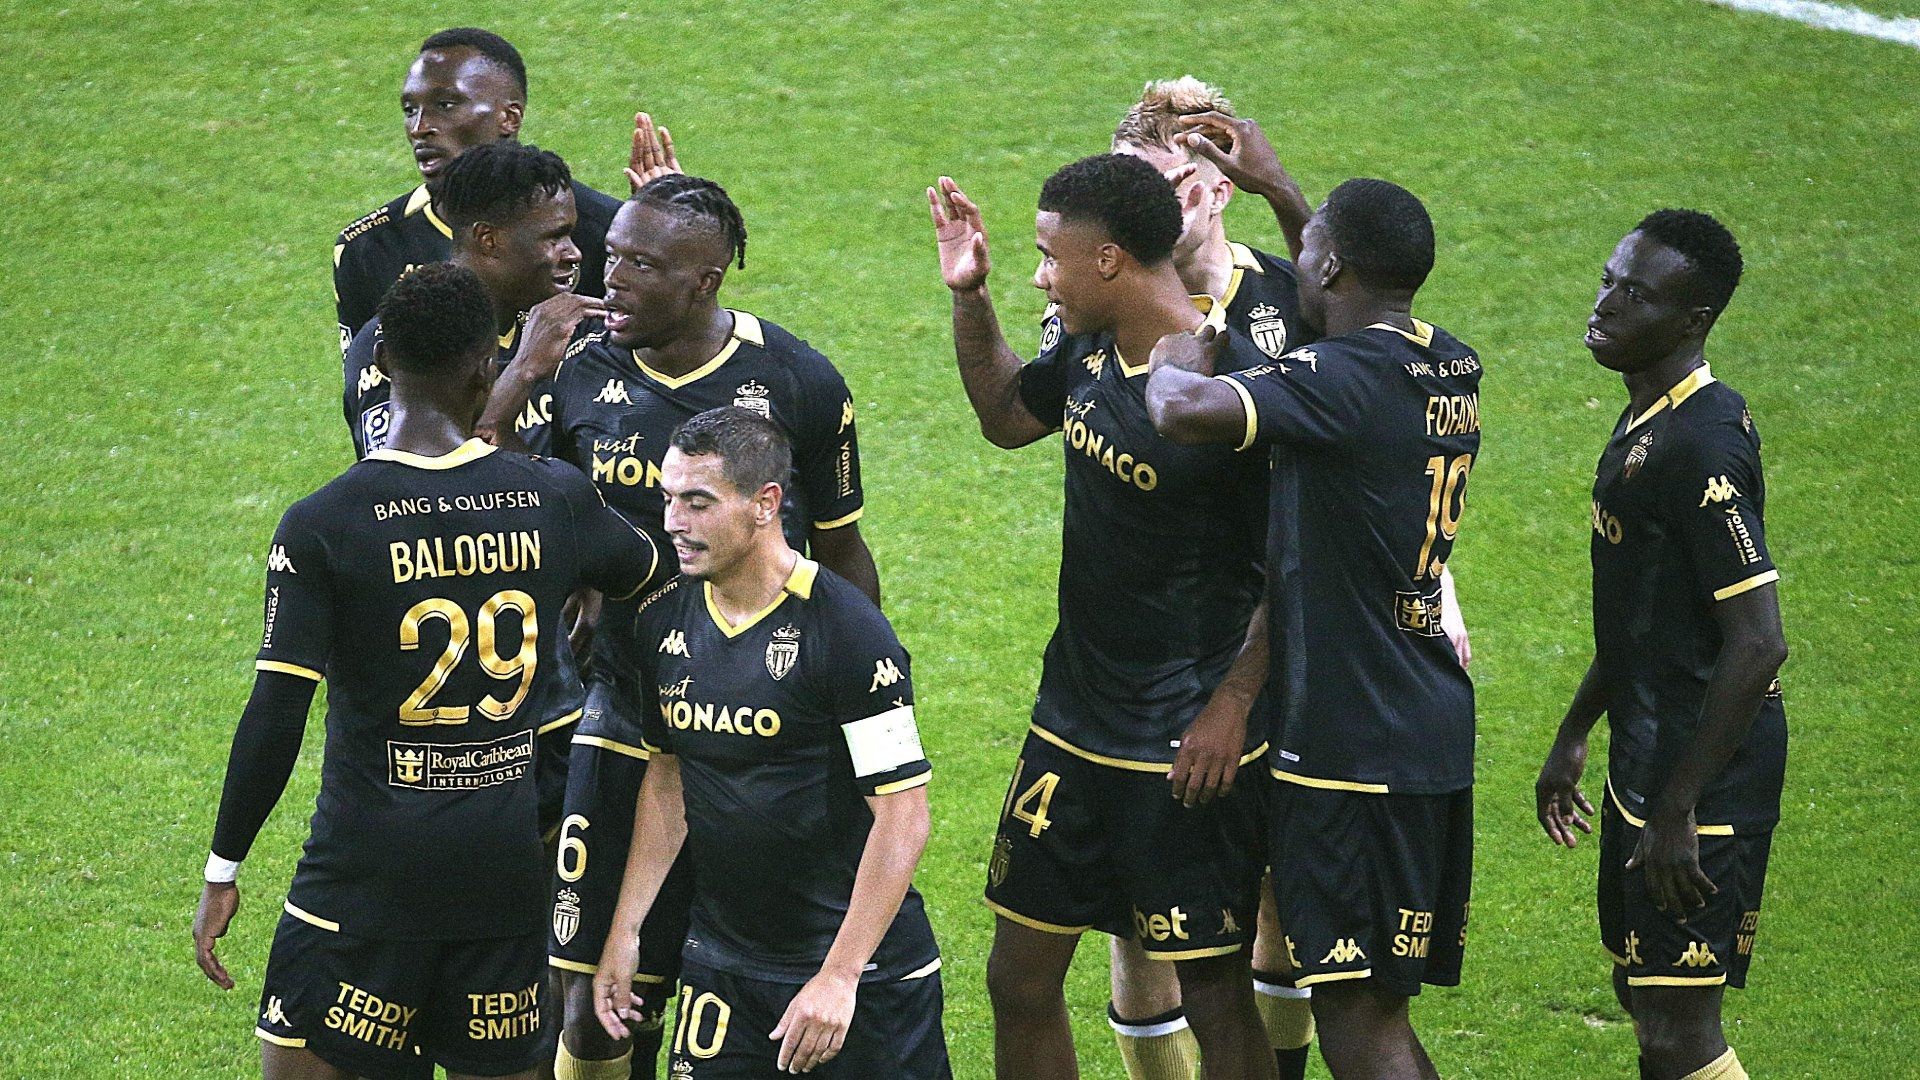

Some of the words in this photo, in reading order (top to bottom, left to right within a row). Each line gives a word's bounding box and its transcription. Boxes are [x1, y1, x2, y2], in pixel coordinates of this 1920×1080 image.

[1439, 362, 1449, 378] &
[593, 432, 645, 455] visit
[1063, 408, 1157, 491] MONACO
[592, 452, 662, 488] MON
[840, 440, 855, 497] yomoni
[374, 497, 432, 521] BANG
[437, 496, 452, 513] &
[454, 491, 541, 512] OLUFSEN
[1413, 452, 1472, 581] 19
[389, 530, 541, 583] BALOGUN
[1725, 503, 1763, 564] yomoni
[263, 586, 279, 649] yomoni
[399, 589, 539, 726] 29
[660, 700, 781, 737] MONACO
[556, 814, 591, 883] 6
[1398, 907, 1433, 933] TED
[338, 981, 418, 1027] TEDDY
[467, 982, 540, 1016] TEDDY
[673, 985, 731, 1059] 10
[324, 1006, 407, 1051] SMITH
[467, 1008, 541, 1041] SMITH
